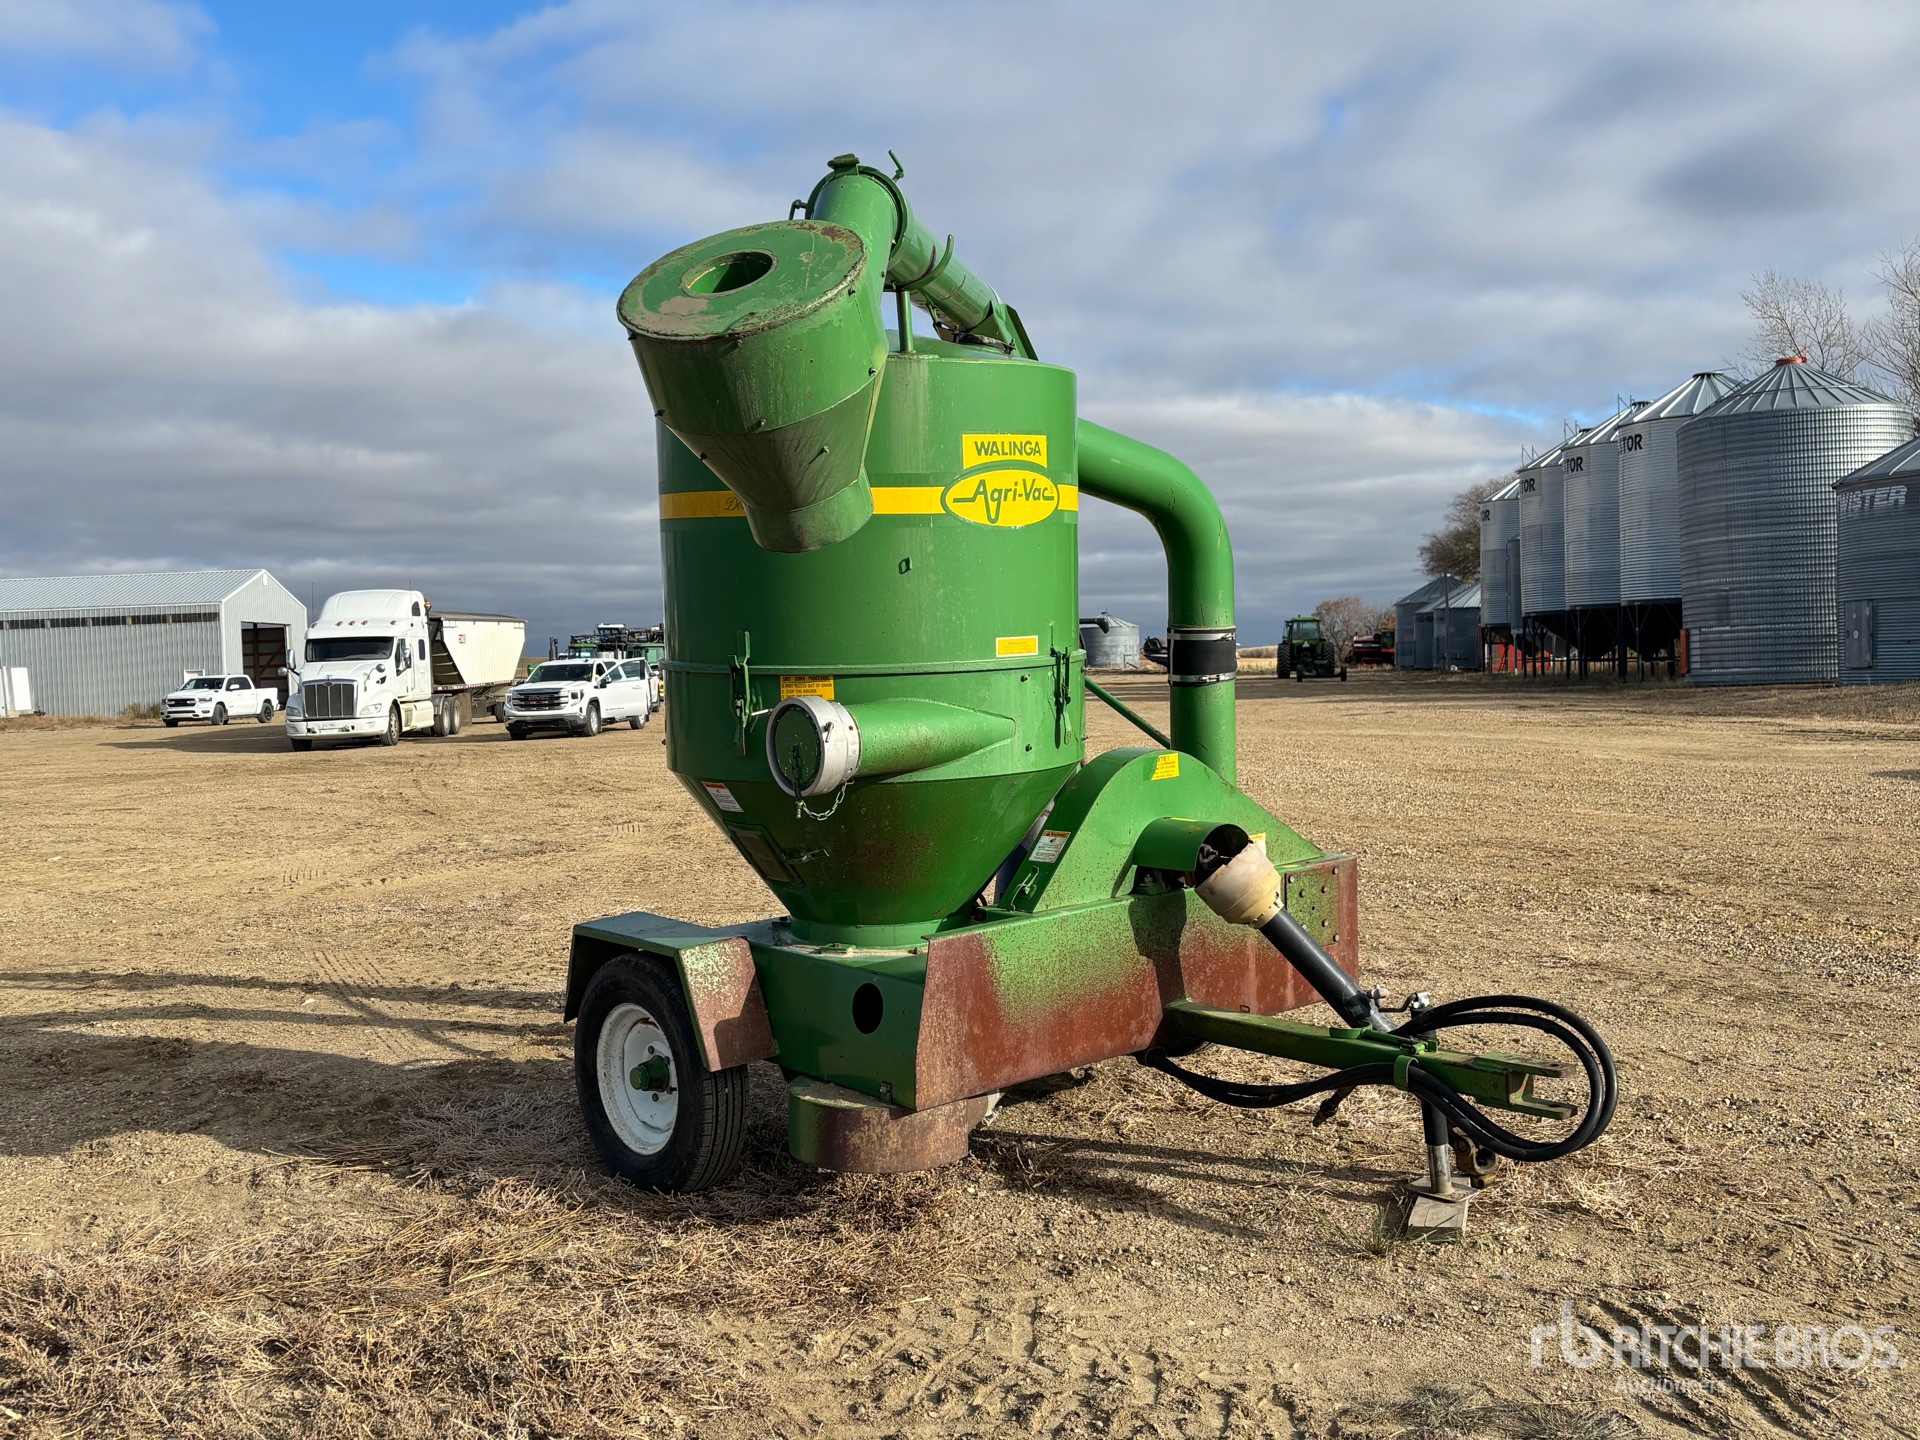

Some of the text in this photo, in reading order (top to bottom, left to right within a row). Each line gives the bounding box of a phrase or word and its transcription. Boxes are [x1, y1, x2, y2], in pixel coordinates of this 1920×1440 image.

[974, 440, 1041, 456] WALINGA
[724, 496, 744, 511] De
[953, 478, 1054, 524] Agri-Vac
